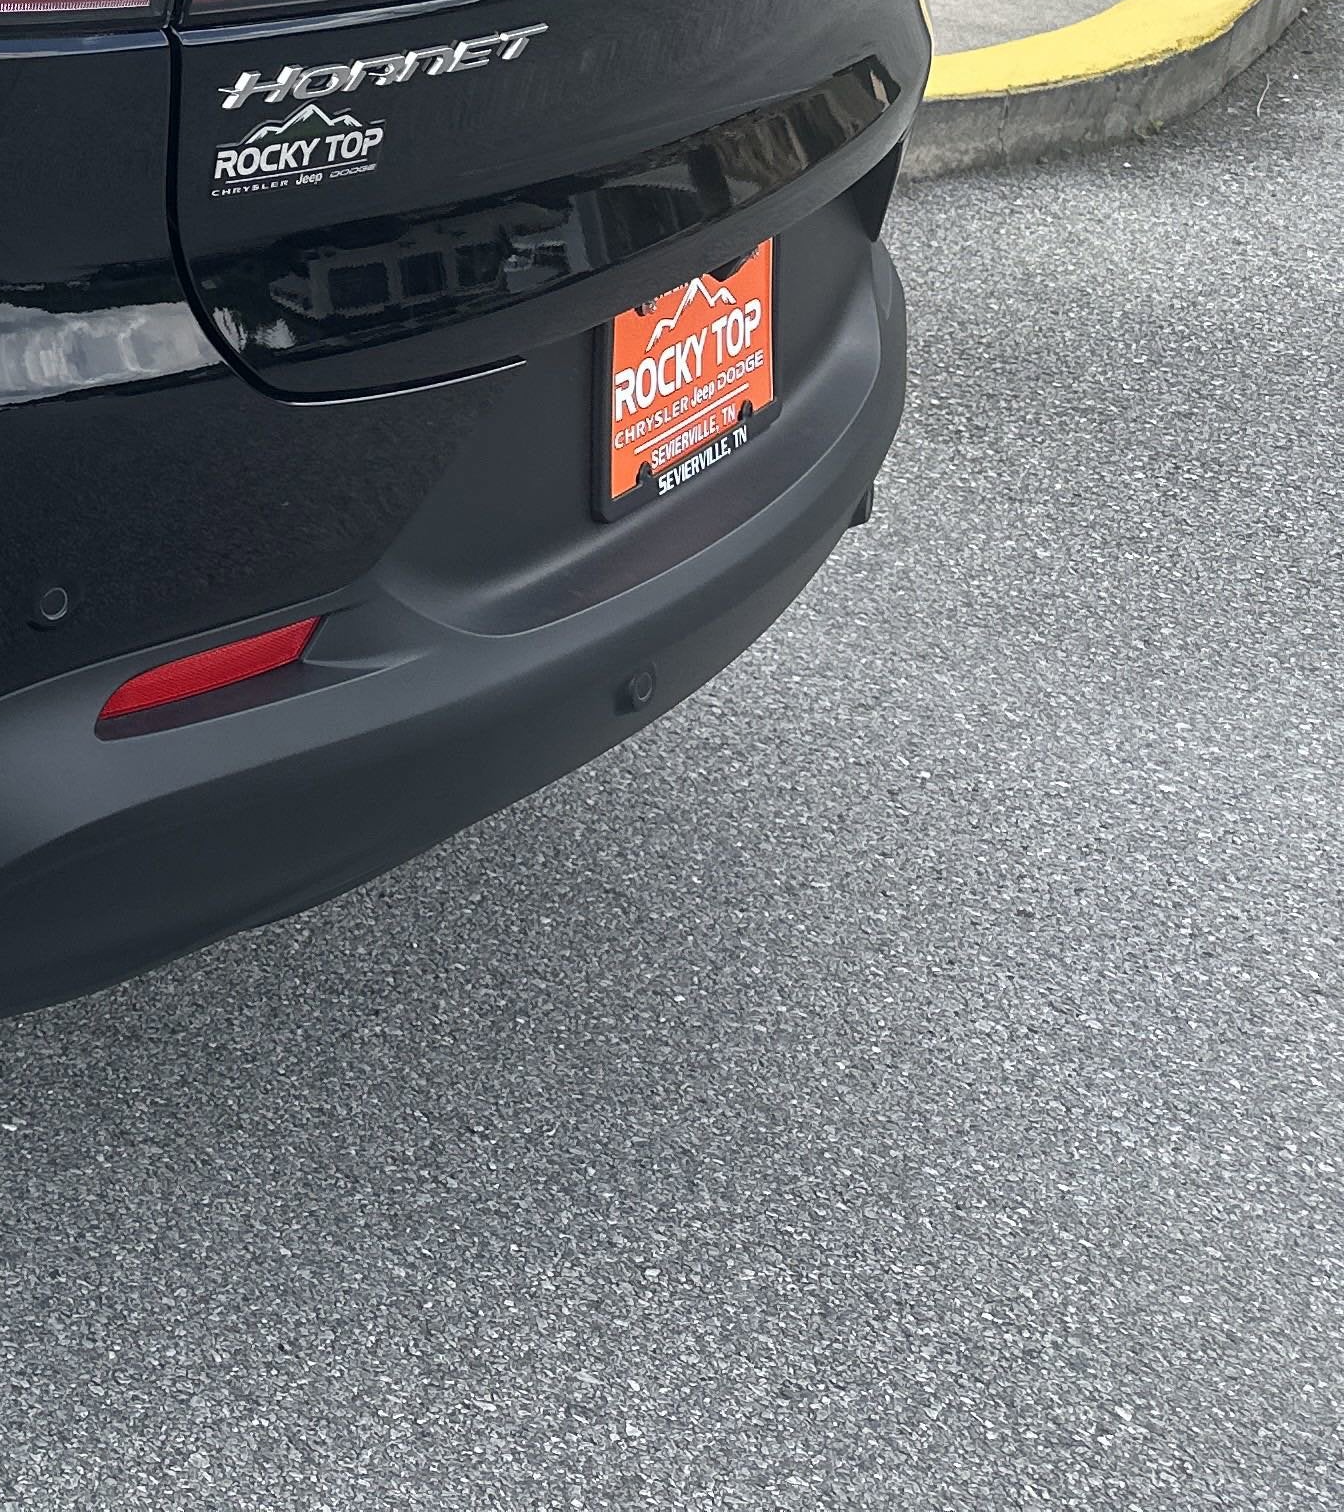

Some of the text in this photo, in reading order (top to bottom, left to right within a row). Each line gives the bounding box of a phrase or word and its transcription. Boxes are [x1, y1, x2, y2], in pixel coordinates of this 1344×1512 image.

[217, 22, 550, 110] HORNET
[211, 164, 378, 197] CHRYSLER Jeep DODGE
[214, 127, 384, 180] ROCKY TOP
[614, 298, 762, 422] ROCKY TOP
[614, 348, 765, 449] CHRYSLER Jeep DODGE
[722, 404, 737, 425] TN
[658, 425, 748, 496] SEVIERVILLE, TN
